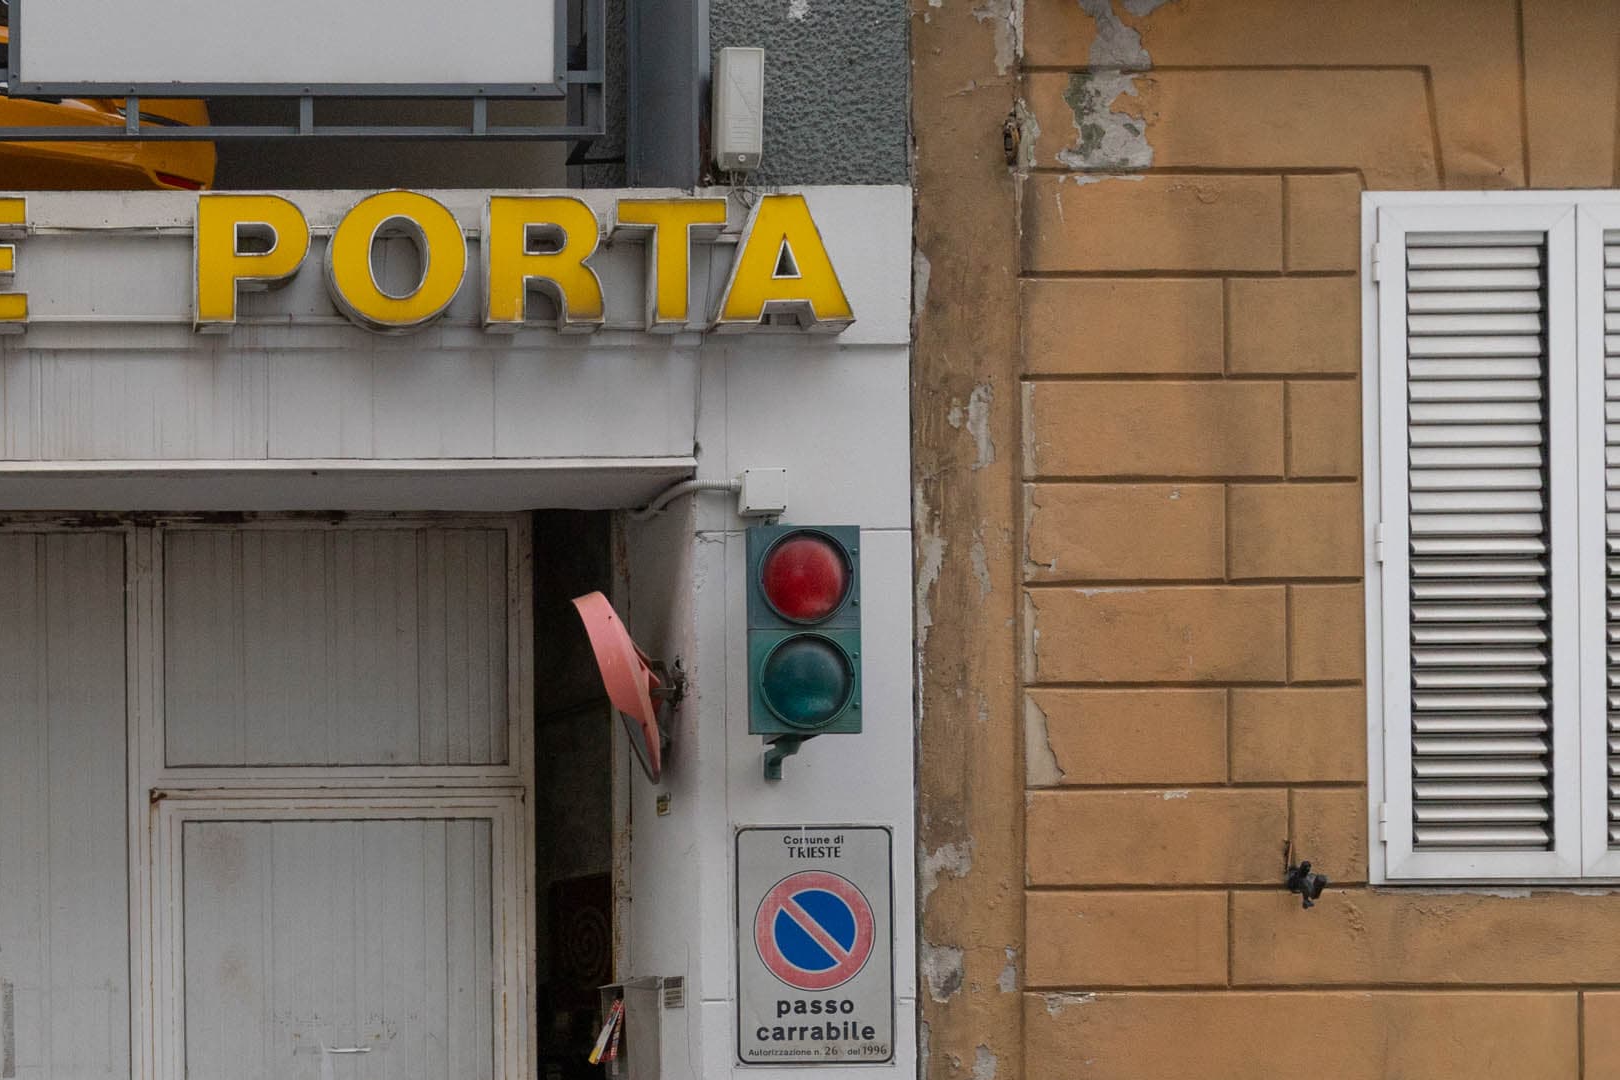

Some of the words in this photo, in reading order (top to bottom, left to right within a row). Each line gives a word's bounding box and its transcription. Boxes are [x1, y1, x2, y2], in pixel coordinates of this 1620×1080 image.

[192, 187, 855, 334] PORTA
[783, 835, 830, 845] Comune
[834, 835, 844, 844] di
[788, 846, 841, 858] TRIESTE
[777, 999, 854, 1018] passo
[756, 1021, 875, 1041] carrabile
[748, 1048, 811, 1056] Autorizzazione
[825, 1046, 838, 1056] 26
[847, 1048, 860, 1056] del
[863, 1045, 887, 1055] 1996
